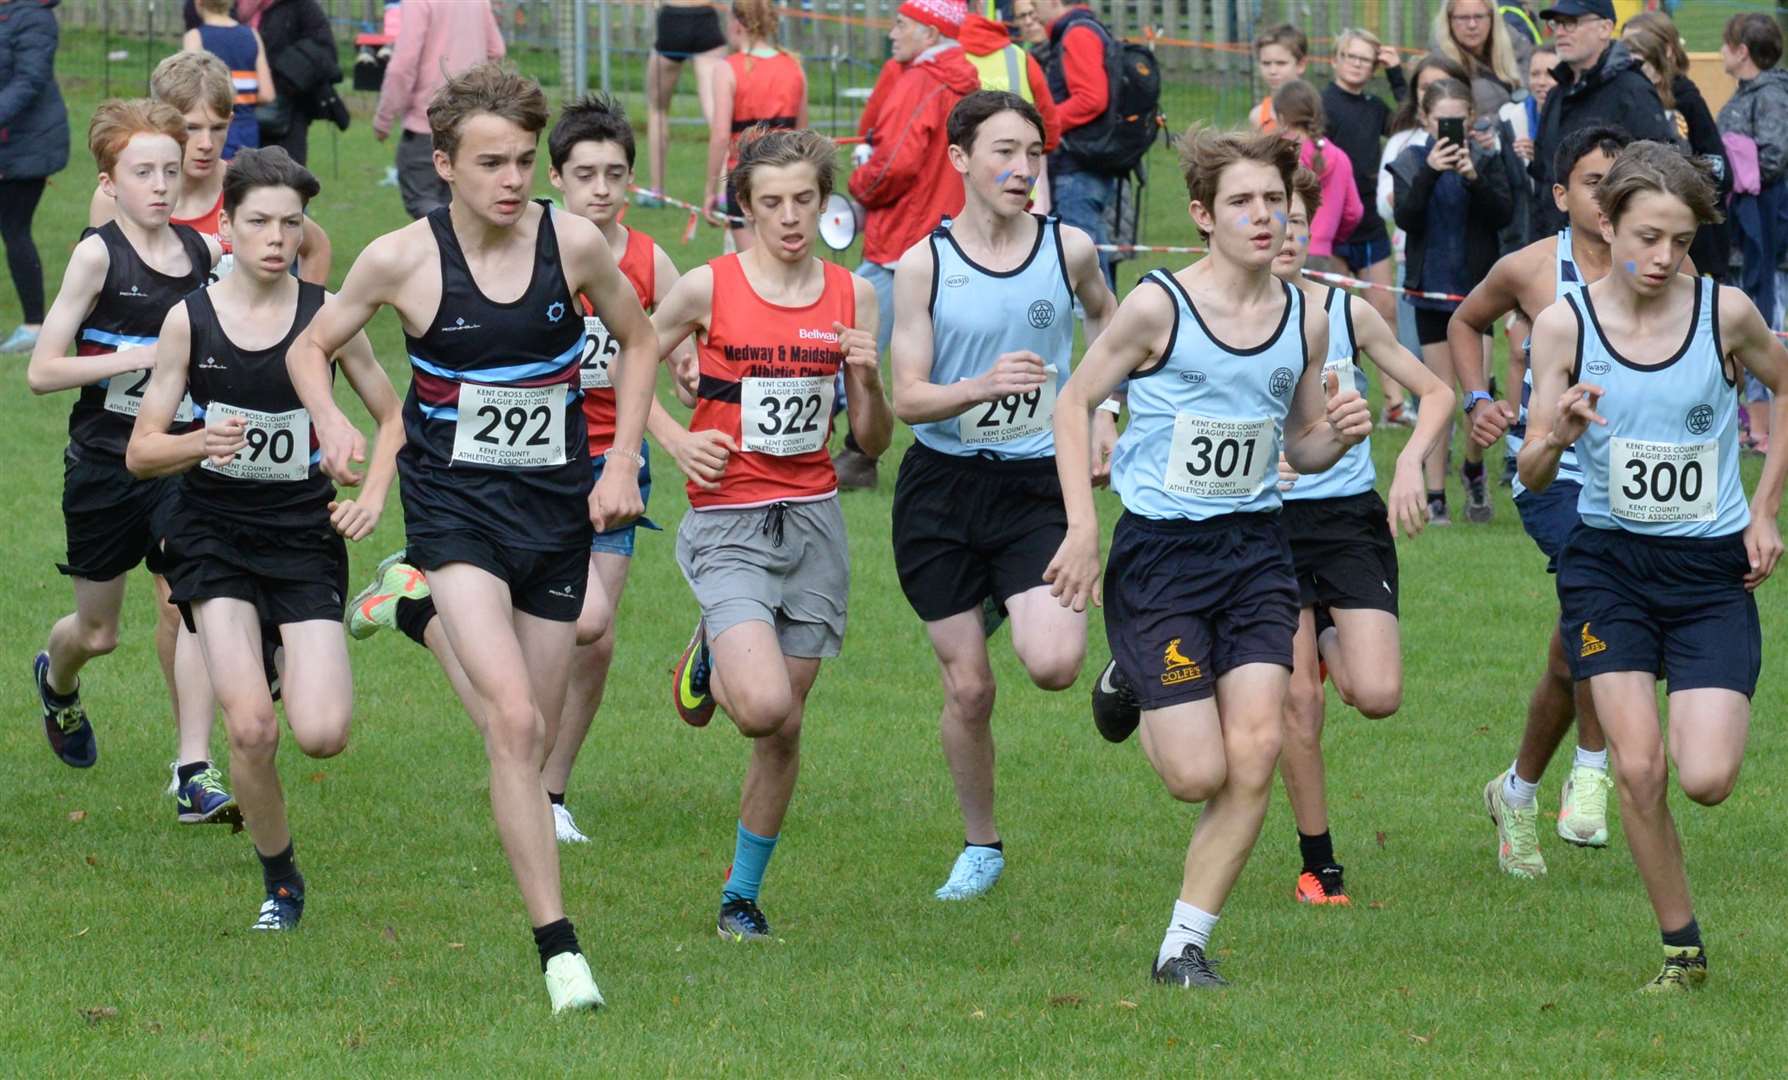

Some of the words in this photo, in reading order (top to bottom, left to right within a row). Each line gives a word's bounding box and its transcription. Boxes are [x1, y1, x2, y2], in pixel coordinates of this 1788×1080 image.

[799, 328, 838, 343] Bellway
[724, 344, 774, 363] Medway
[778, 345, 786, 362] &
[750, 364, 795, 378] Athletic
[497, 390, 523, 398] CROSS
[524, 389, 554, 398] COUNTRY
[483, 398, 512, 406] LEAGUE
[514, 397, 549, 406] 2021-2022
[977, 386, 1041, 428] 299
[109, 403, 138, 414] ATHLETIC
[221, 407, 238, 416] KENT
[758, 394, 822, 436] 322
[473, 405, 552, 447] 292
[1001, 424, 1027, 435] COUNTY
[1211, 422, 1235, 430] CROSS
[1237, 422, 1265, 430] COUNTRY
[1002, 426, 1043, 441] ASSOCIATION
[1197, 429, 1225, 437] LEAGUE
[1227, 430, 1260, 438] 2021-2022
[234, 427, 294, 465] 90
[764, 439, 780, 447] KENT
[1625, 442, 1644, 450] KENT
[1646, 445, 1671, 453] CROSS
[1673, 445, 1704, 453] COUNTRY
[458, 451, 495, 464] ATHLETICS
[497, 456, 548, 465] ASSOCIATION
[479, 447, 497, 456] KENT
[500, 449, 530, 458] COUNTY
[1186, 436, 1256, 478] 301
[1632, 452, 1661, 460] LEAGUE
[1663, 453, 1698, 461] 2021-2022
[240, 471, 290, 480] ASSOCIATION
[1622, 459, 1703, 502] 300
[1169, 484, 1204, 495] ATHLETICS
[1207, 488, 1251, 496] ASSOCIATION
[1209, 481, 1236, 489] COUNTY
[1612, 507, 1645, 520] ATHLETICS
[1647, 512, 1698, 521] ASSOCIATION
[1628, 504, 1648, 512] KENT
[1649, 505, 1680, 513] COUNTY
